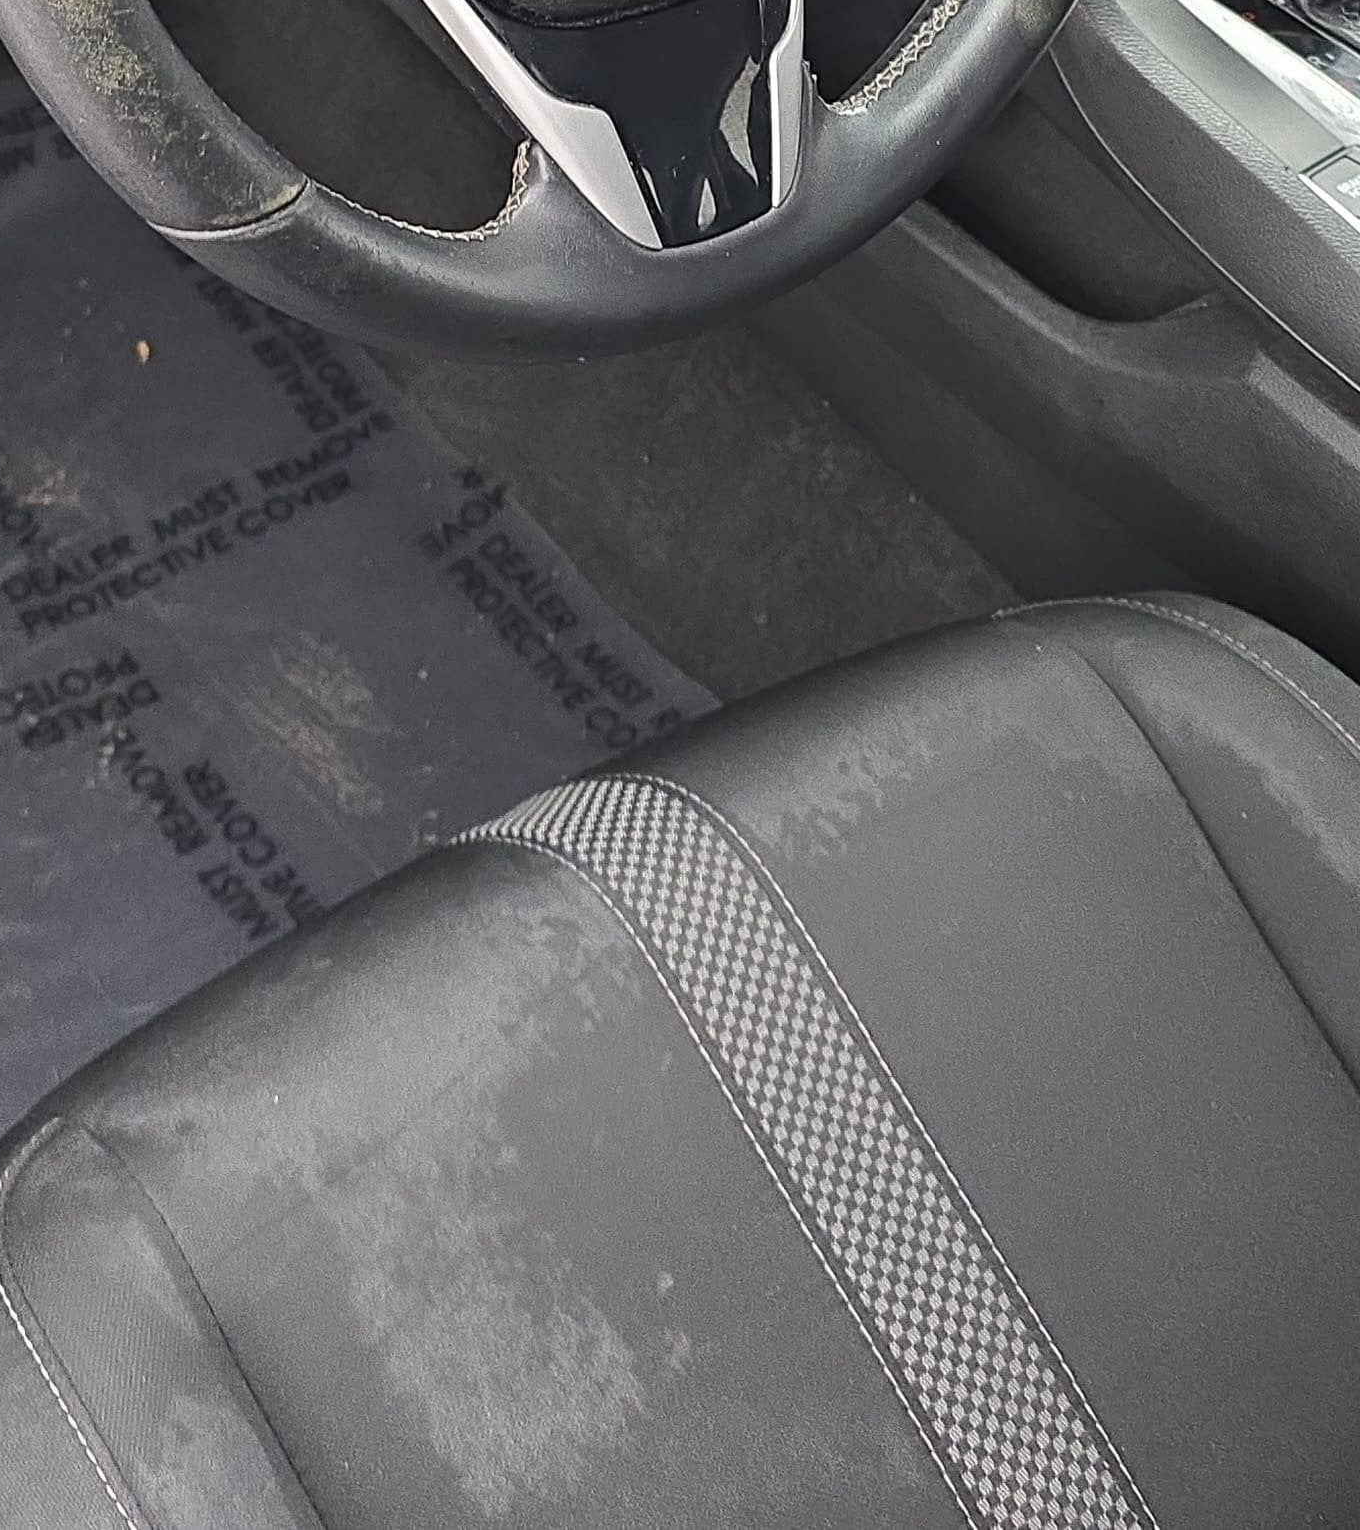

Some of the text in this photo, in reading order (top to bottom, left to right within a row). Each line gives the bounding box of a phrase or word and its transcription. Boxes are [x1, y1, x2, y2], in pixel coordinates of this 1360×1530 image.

[0, 408, 396, 607] DEALER MUST REMOVE
[16, 469, 353, 639] PROTECTIVE COVER
[477, 530, 580, 636] DEALER
